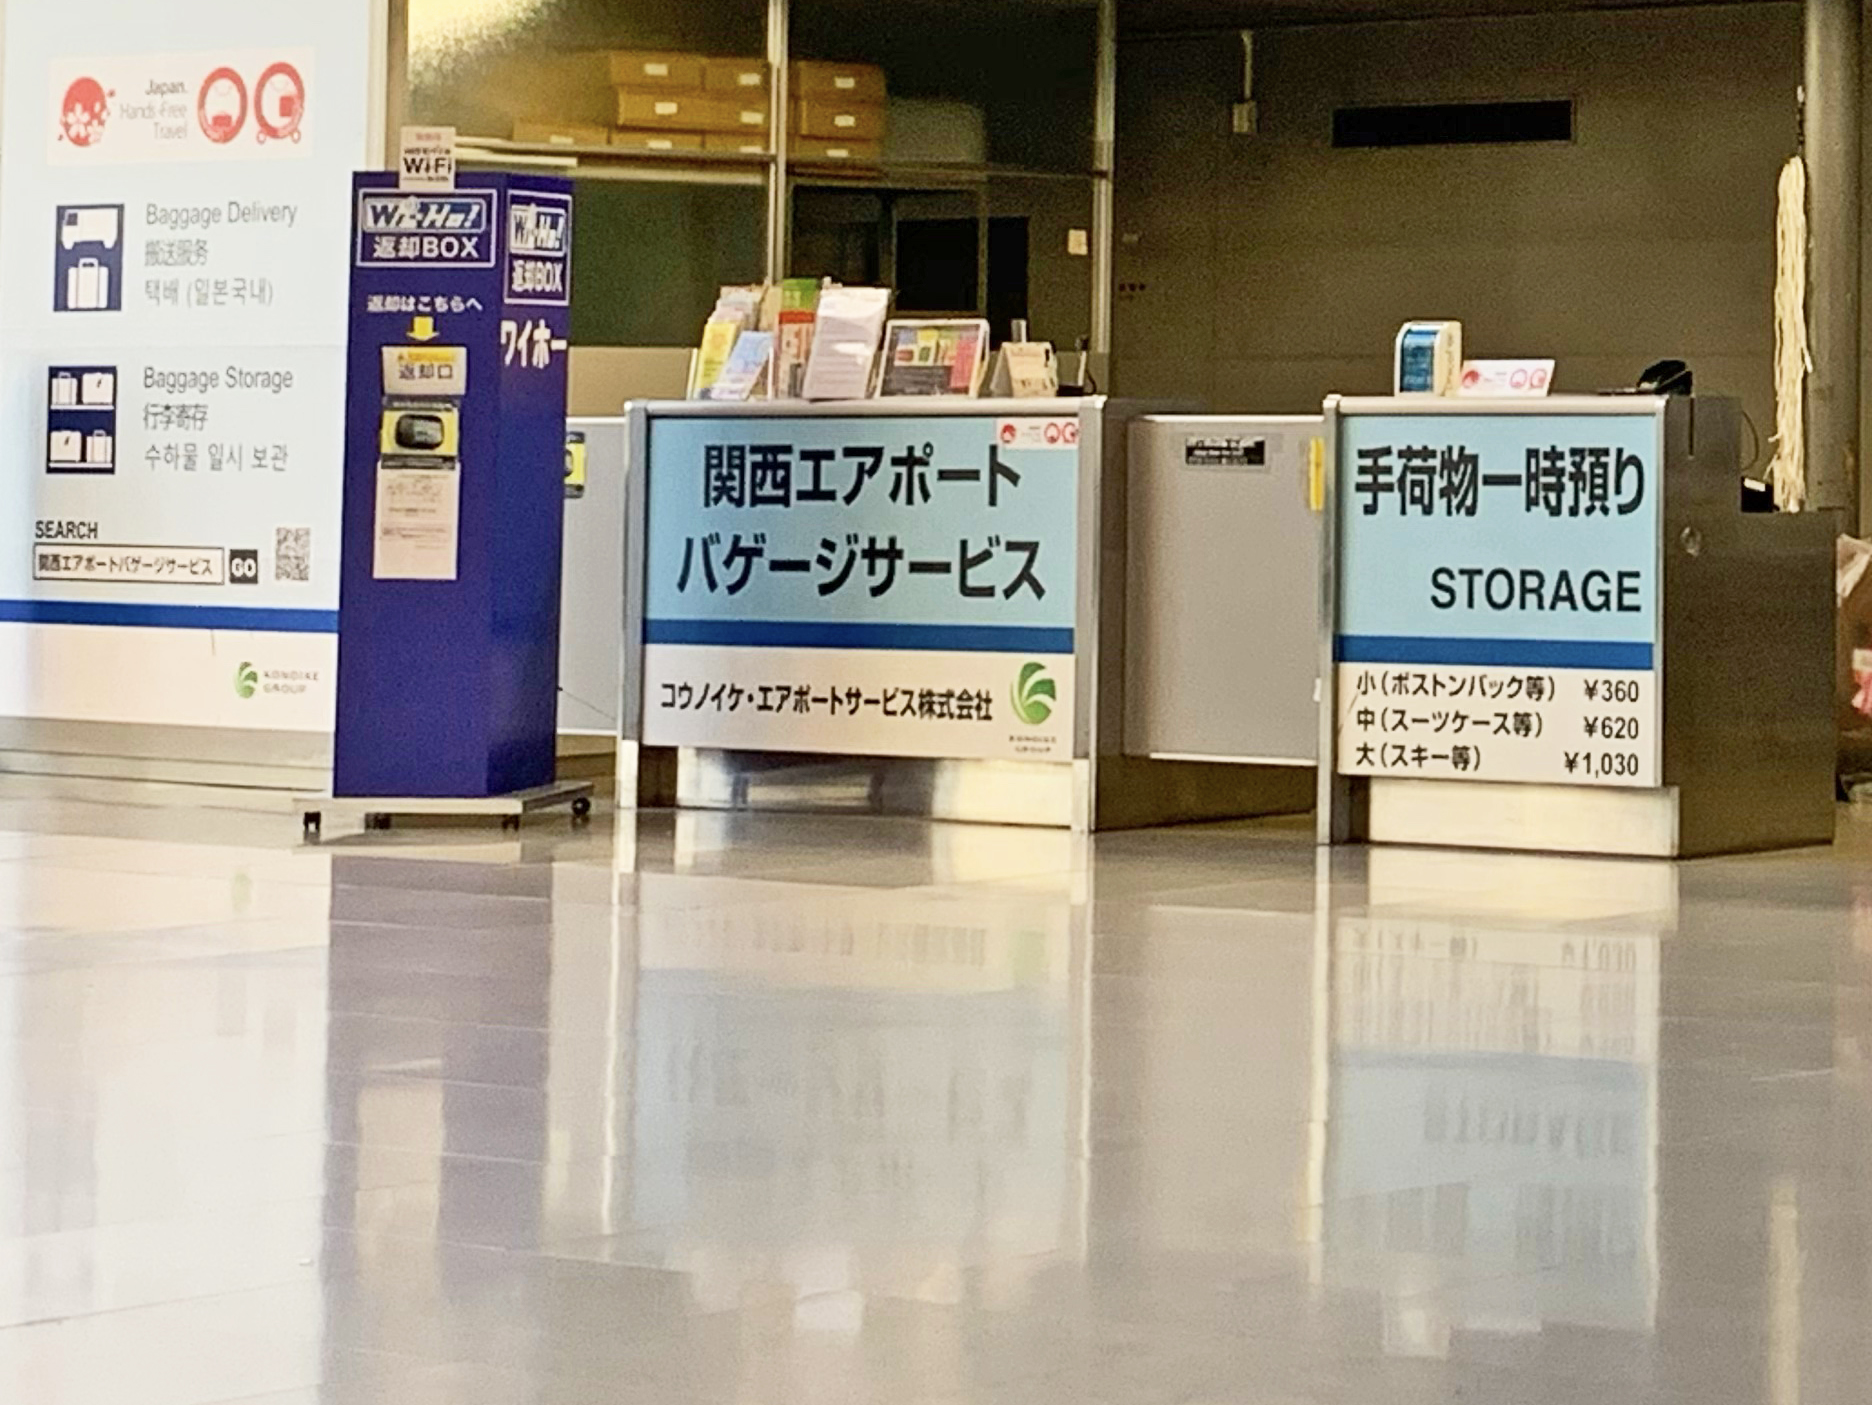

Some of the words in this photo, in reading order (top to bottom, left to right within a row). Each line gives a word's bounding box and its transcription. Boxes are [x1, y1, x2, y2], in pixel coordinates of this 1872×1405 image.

[153, 122, 188, 139] Travel
[146, 203, 222, 230] Baggage
[228, 201, 297, 227] Delivery
[373, 236, 479, 259] 返却BOX
[512, 260, 563, 293] 返却BOX
[367, 295, 483, 313] 返却はこちらへ
[501, 319, 567, 369] ワイホー
[143, 367, 220, 393] Baggage
[225, 366, 293, 393] Storage
[144, 443, 198, 472] 수하물
[208, 443, 243, 472] 일시
[252, 444, 289, 473] 보관
[703, 442, 1022, 507] 関西エアポート
[1355, 444, 1645, 518] 手荷物一時預り
[35, 521, 98, 539] SEARCH
[231, 557, 257, 579] GO
[677, 532, 1046, 601] バゲージサービス
[1429, 567, 1642, 613] STORAGE
[1584, 679, 1639, 703] ¥360
[1584, 716, 1639, 740] ¥620
[1564, 751, 1639, 779] ¥1,030
